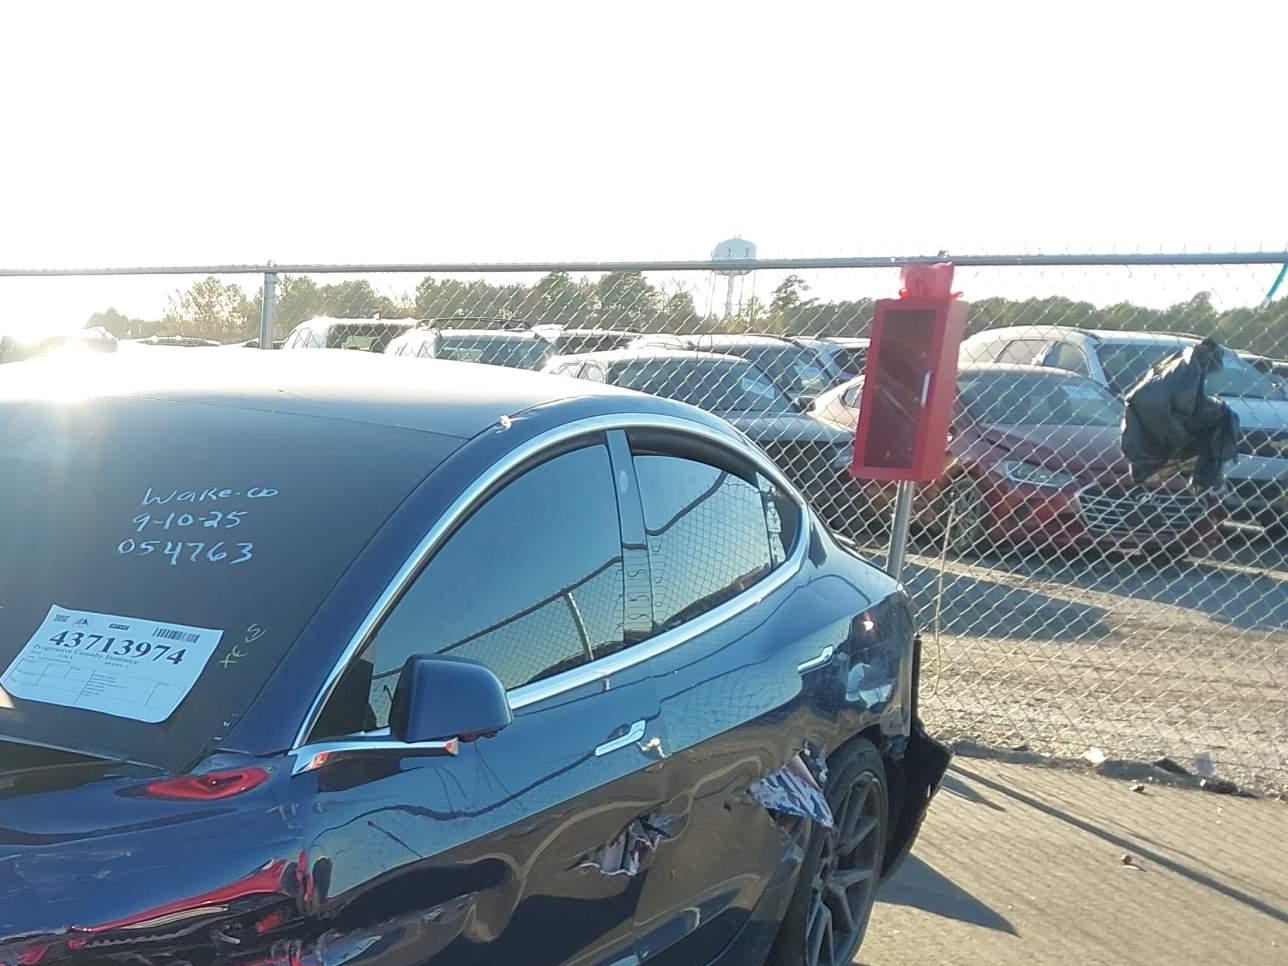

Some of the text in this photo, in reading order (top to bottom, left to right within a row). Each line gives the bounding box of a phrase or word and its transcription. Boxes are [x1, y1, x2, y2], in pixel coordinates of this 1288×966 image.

[132, 510, 249, 532] 9-10-25
[117, 538, 255, 566] 054763
[49, 630, 187, 665] 43713974
